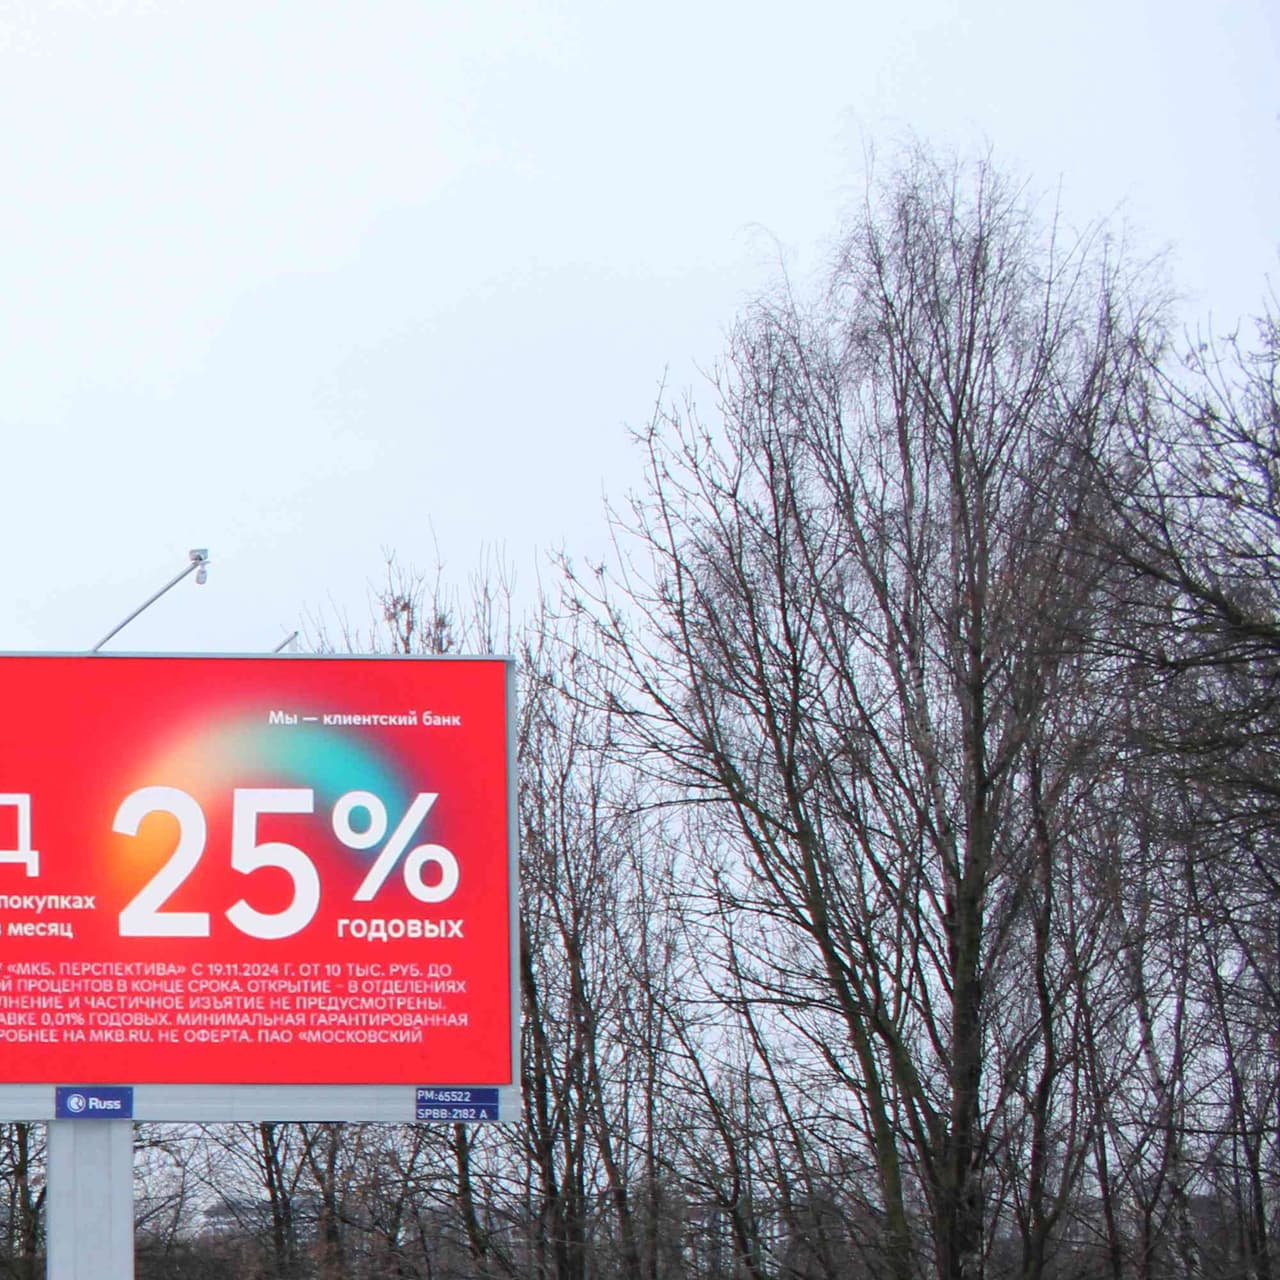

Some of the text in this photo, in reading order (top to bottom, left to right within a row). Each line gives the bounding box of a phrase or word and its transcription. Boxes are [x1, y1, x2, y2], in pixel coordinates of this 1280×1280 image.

[268, 710, 298, 725] Мы
[323, 710, 418, 726] клиентский
[422, 711, 461, 726] банк
[112, 785, 460, 940] 25%
[7, 922, 74, 939] месяц
[337, 919, 464, 942] годовых
[7, 963, 55, 976] «МКБ.
[60, 963, 186, 976] ПЕРСПЕКТИВА»
[191, 963, 203, 976] С
[207, 963, 279, 976] 19.11.2024
[284, 963, 295, 976] Г.
[299, 963, 320, 976] ОТ
[325, 963, 341, 976] 10
[346, 963, 385, 976] ТЫС.
[389, 964, 423, 977] РУБ.
[427, 964, 452, 979] ДО
[17, 980, 113, 995] ПРОЦЕНТОВ
[117, 980, 128, 993] В
[131, 980, 184, 995] КОНЦЕ
[188, 980, 244, 993] СРОКА.
[248, 980, 331, 993] ОТКРЫТИЕ
[348, 980, 359, 993] В
[362, 981, 466, 996] ОТДЕЛЕНИЯХ
[68, 996, 80, 1009] И
[84, 997, 184, 1010] ЧАСТИЧНОЕ
[189, 997, 264, 1010] ИЗЪЯТИЕ
[270, 997, 291, 1010] НЕ
[296, 997, 446, 1013] ПРЕДУСМОТРЕНЫ.
[41, 1013, 85, 1029] 0,01%
[89, 1013, 172, 1029] ГОДОВЫХ.
[176, 1013, 306, 1026] МИНИМАЛЬНАЯ
[310, 1014, 468, 1027] ГАРАНТИРОВАННАЯ
[63, 1030, 86, 1043] НА
[89, 1030, 154, 1043] MKB.RU.
[158, 1030, 179, 1043] НЕ
[184, 1030, 253, 1043] ОФЕРТА.
[258, 1030, 293, 1043] ПАО
[298, 1027, 422, 1043] «МОСКОВСКИЙ
[88, 1098, 121, 1109] Russ
